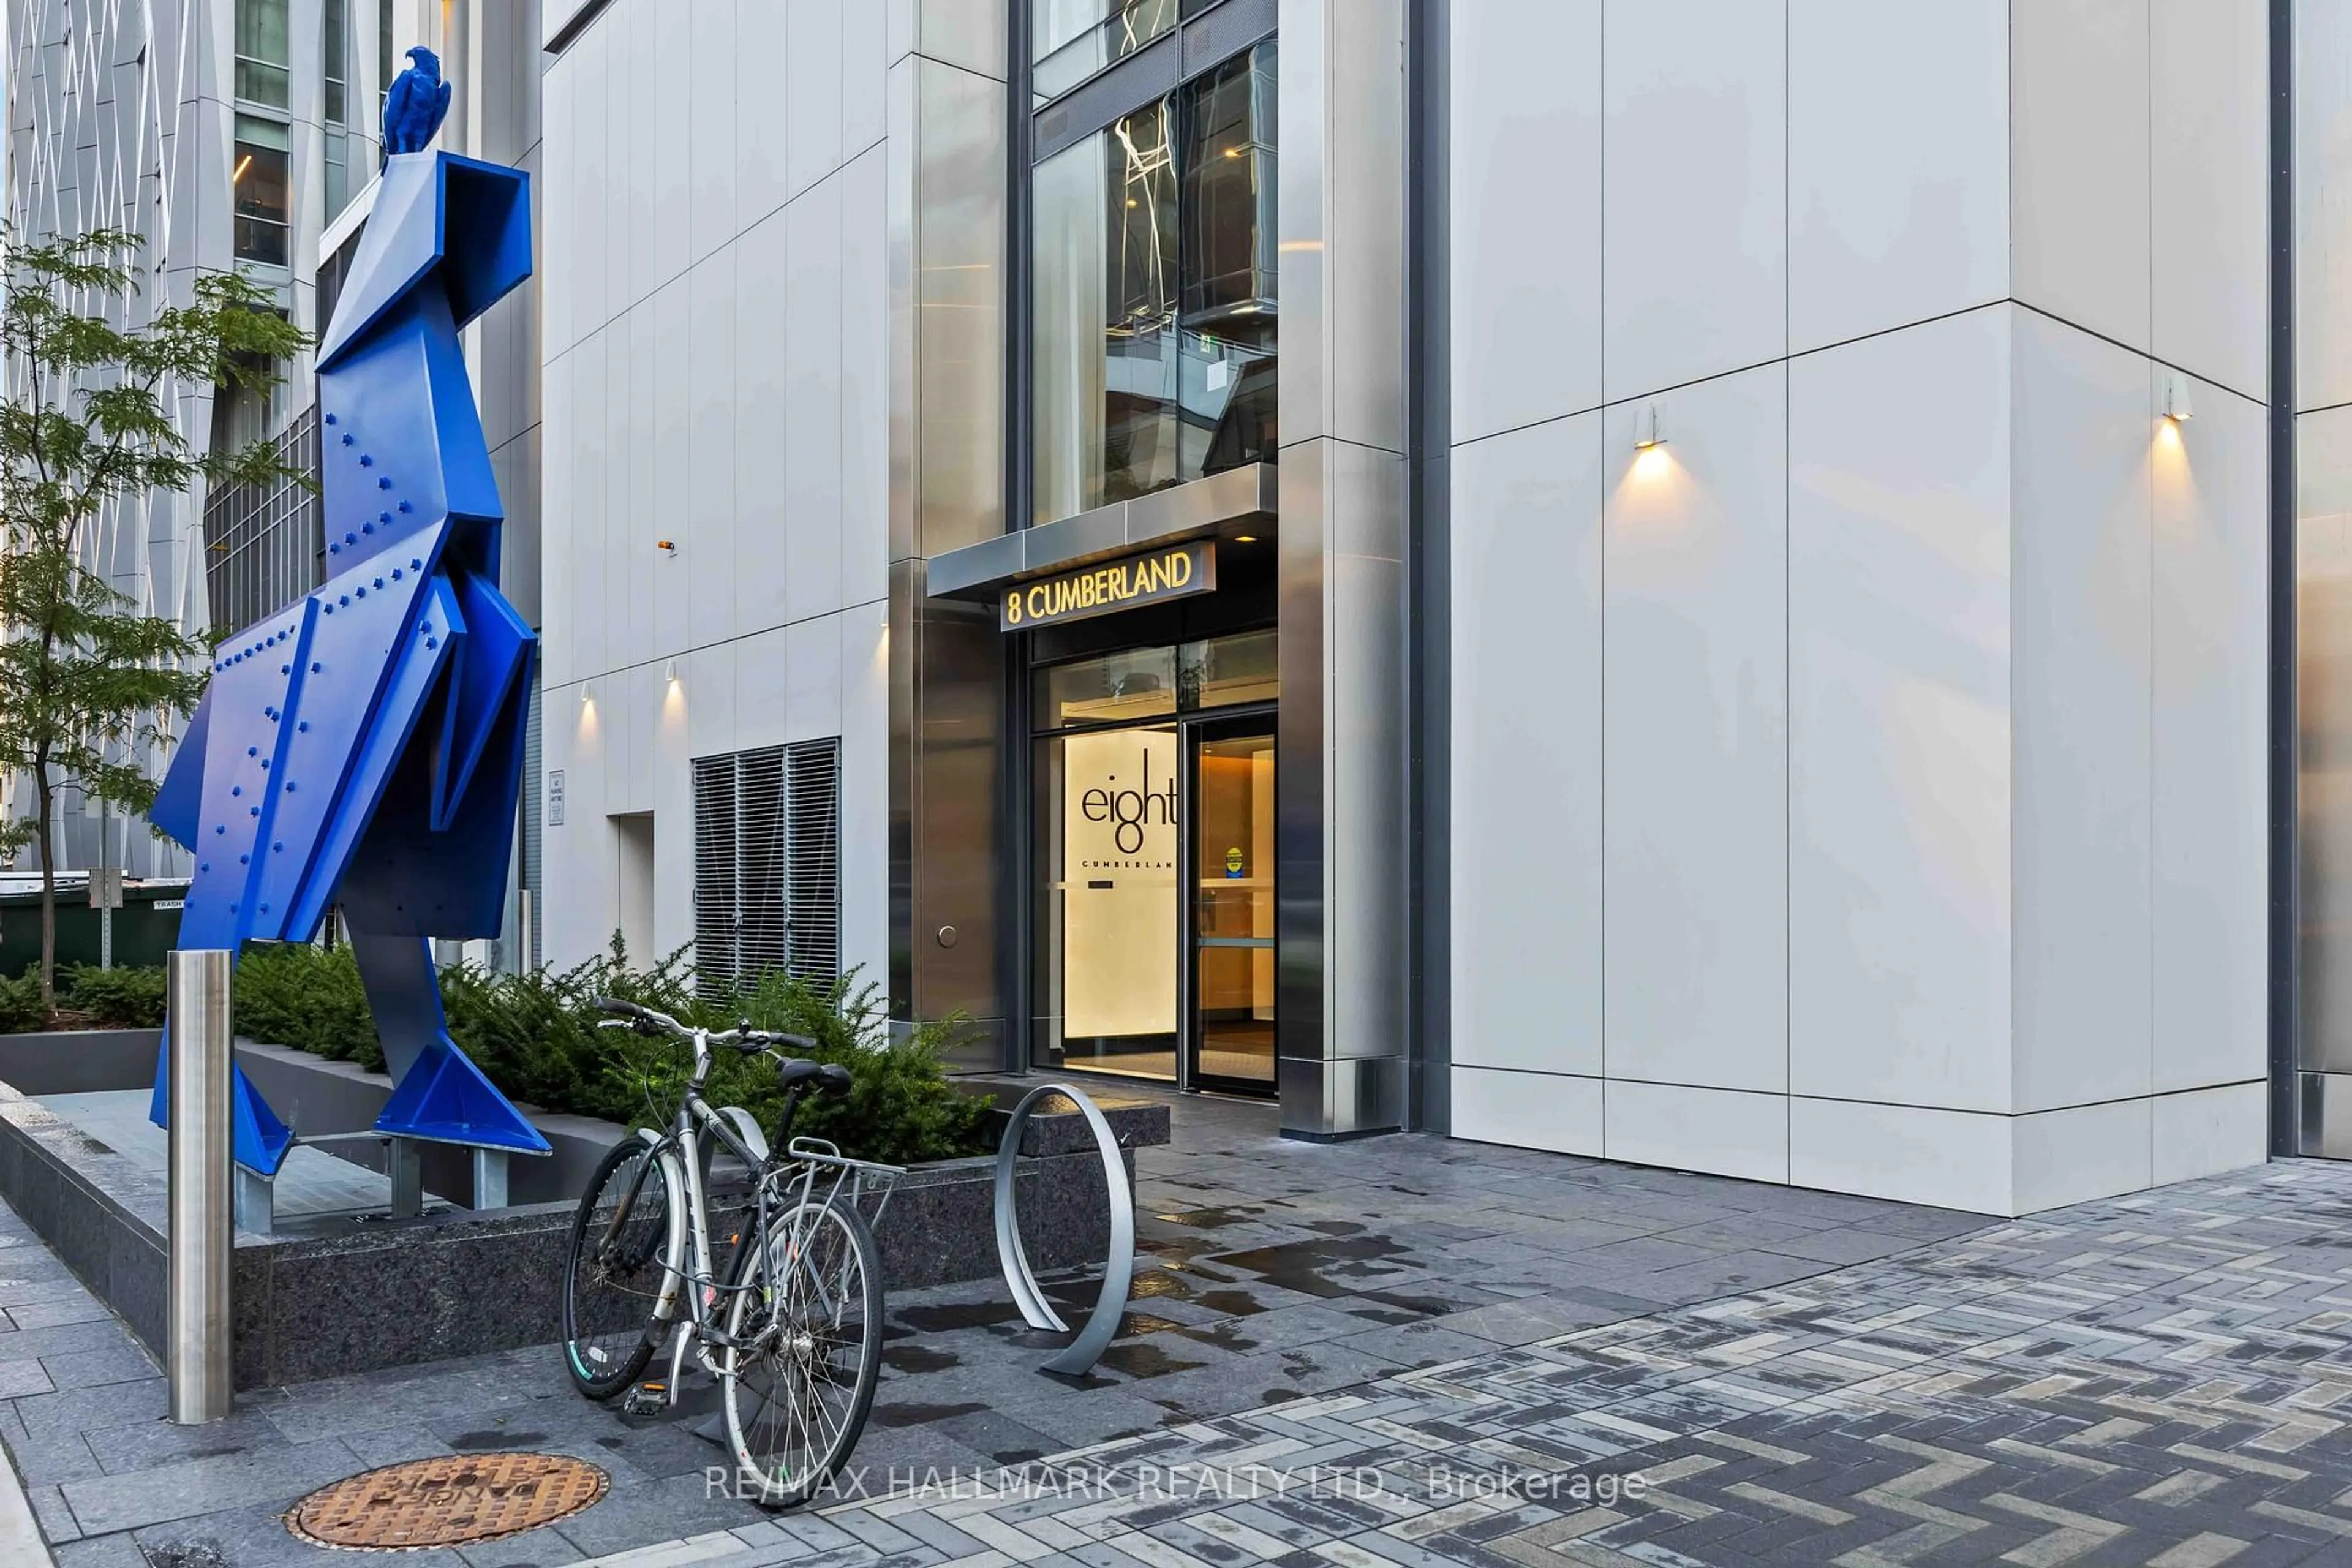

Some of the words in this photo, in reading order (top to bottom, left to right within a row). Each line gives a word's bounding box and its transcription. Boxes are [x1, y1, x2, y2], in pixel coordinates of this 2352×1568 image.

[1008, 592, 1022, 624] 8
[1027, 552, 1191, 619] CUMBERLAND
[1082, 748, 1177, 854] eight
